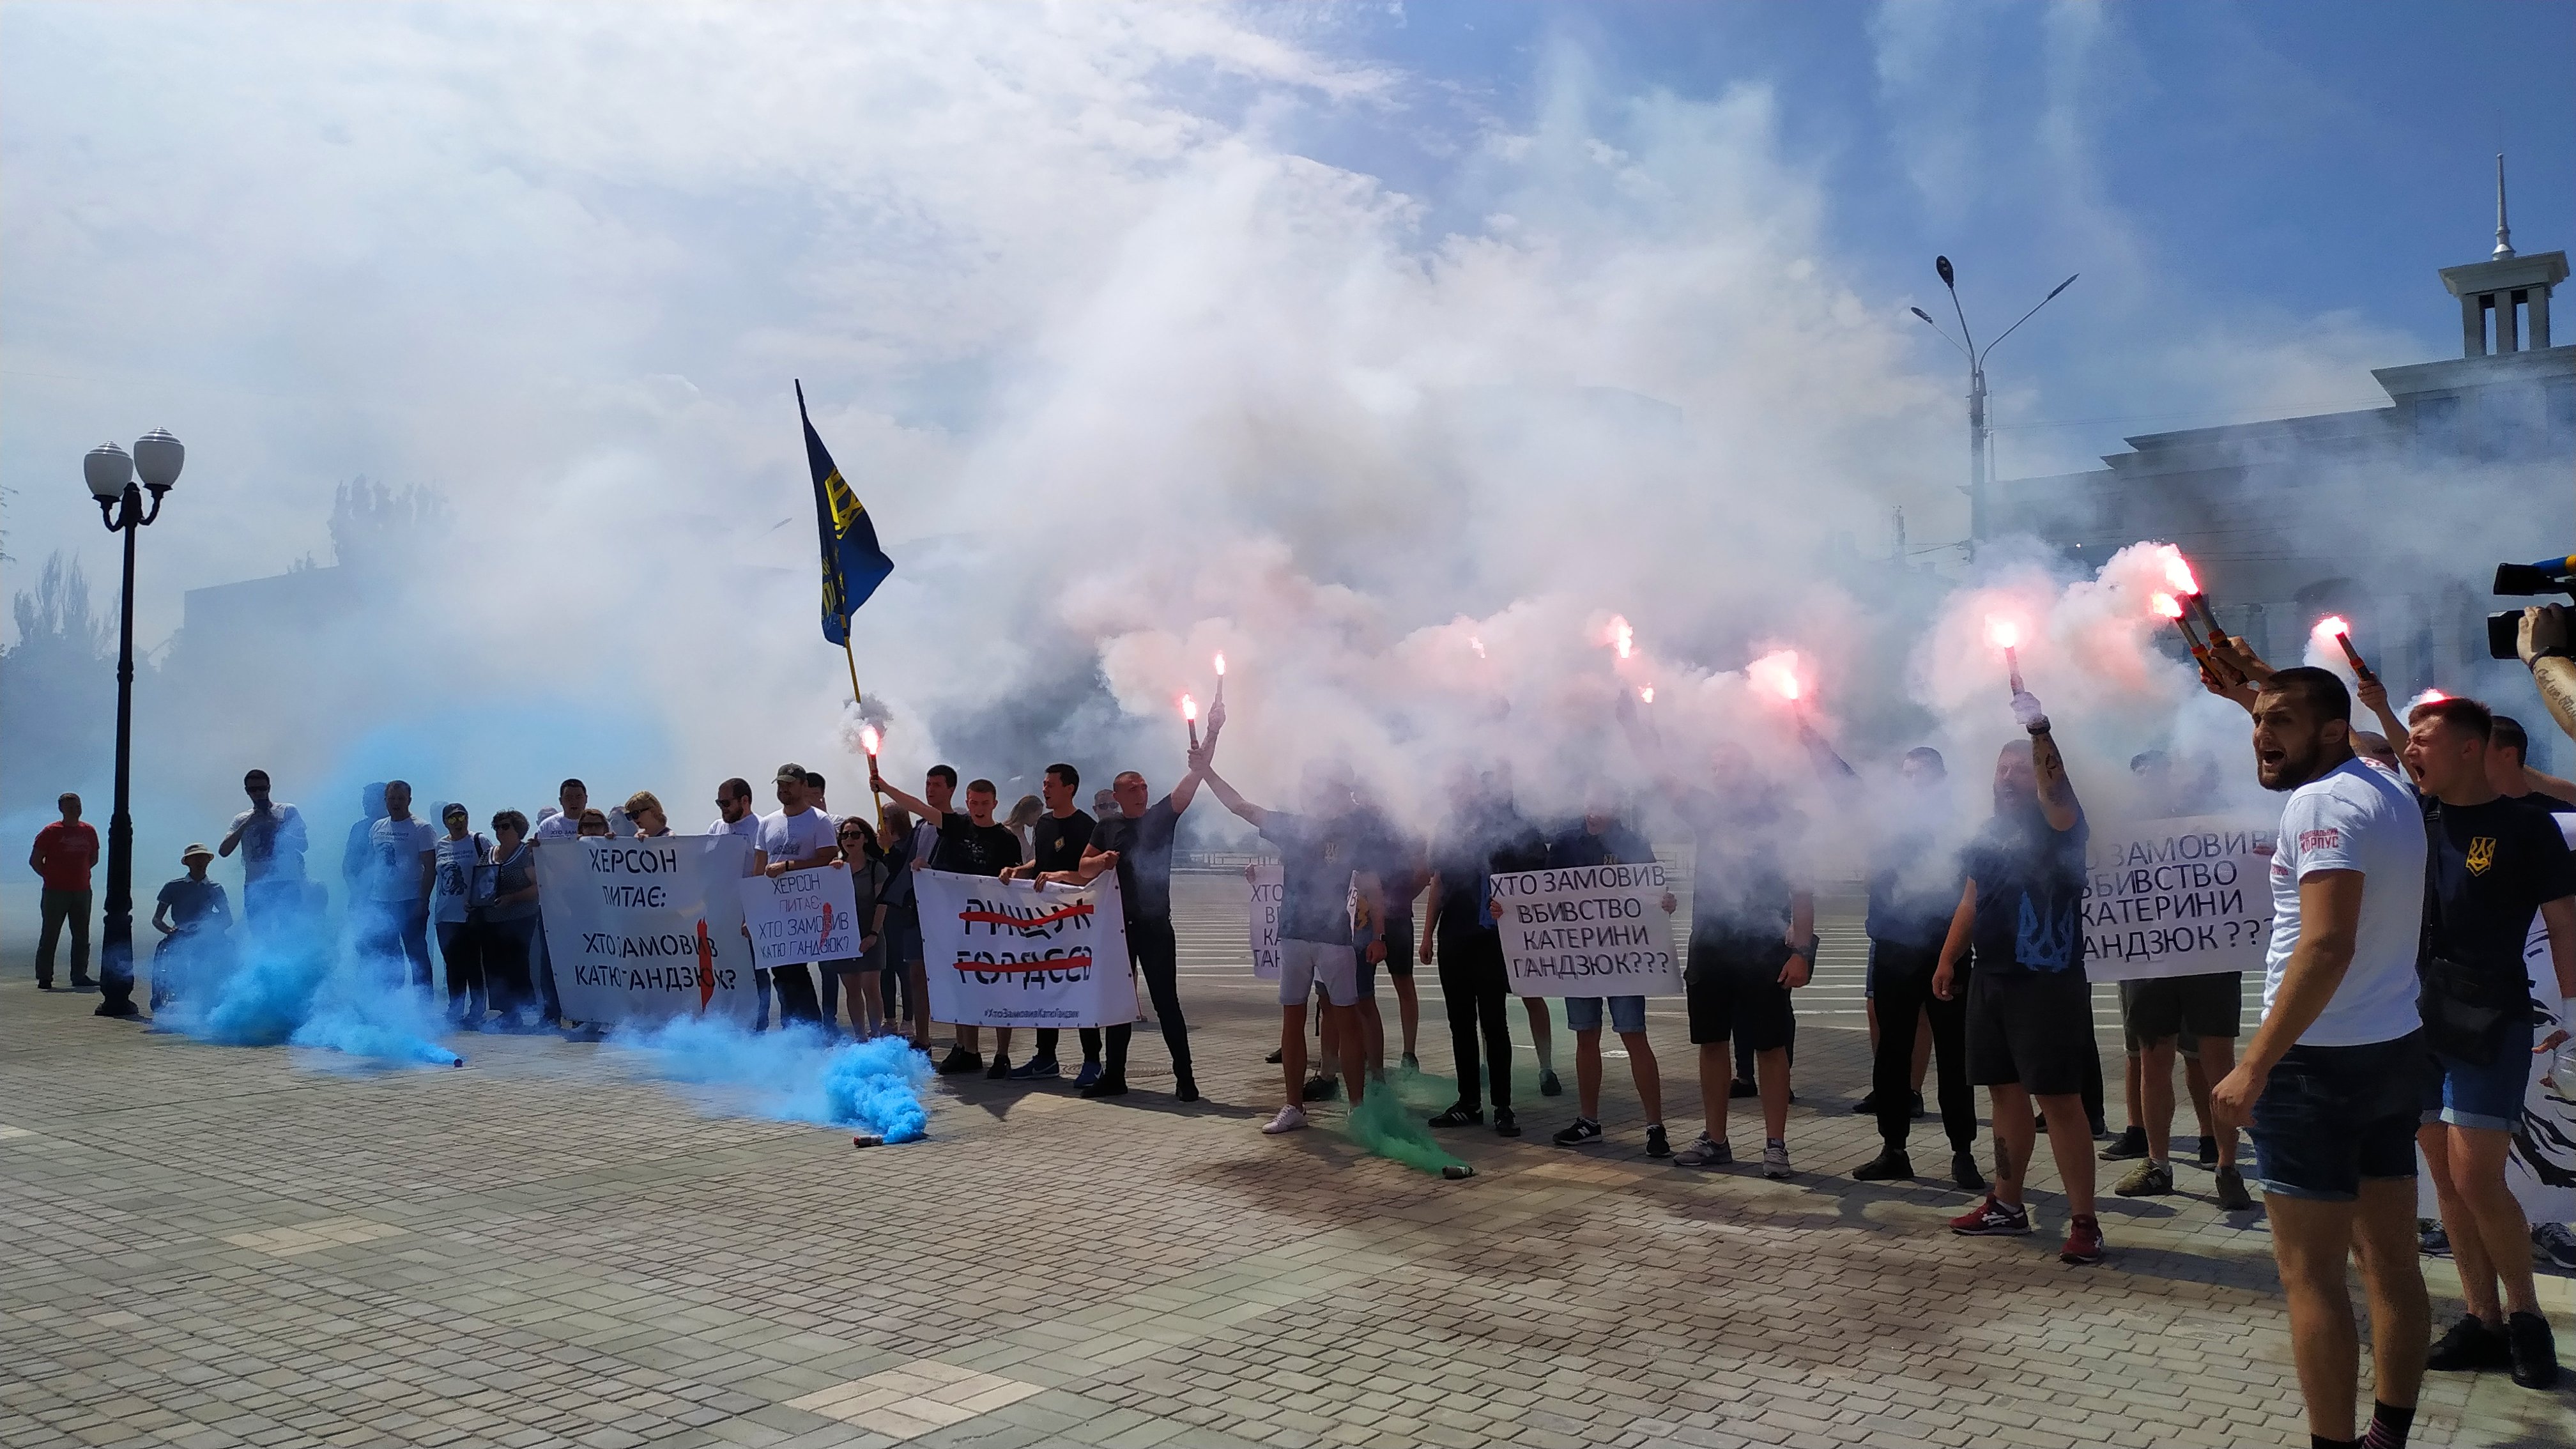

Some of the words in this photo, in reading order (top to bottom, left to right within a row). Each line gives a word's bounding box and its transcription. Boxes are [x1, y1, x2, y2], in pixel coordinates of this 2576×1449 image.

[2301, 836, 2339, 854] КОРПУС
[589, 848, 677, 873] ХЕРСОН
[772, 873, 820, 894] ХЕРСОН
[1251, 884, 1283, 902] ХТО
[1490, 874, 1537, 898] ХТО
[1544, 865, 1666, 893] ЗАМОВИВ
[602, 885, 666, 907] ПИТАЄ:
[779, 895, 822, 913] ПИТАЄ:
[1515, 898, 1641, 924] ВБИВСТВО
[758, 920, 783, 940] ХТО
[787, 912, 849, 936] ЗАМОВИВ
[1523, 925, 1650, 951] КАТЕРИНИ
[583, 933, 615, 954] ХТО
[617, 935, 718, 958] АМОВИВ
[760, 942, 786, 958] КАТЮ
[790, 935, 849, 956] ГАНДЗЮК?
[1513, 951, 1669, 980] ГАНДЗЮК???
[575, 965, 621, 988] КАТЮ
[622, 967, 737, 992] АНДЗЮК?
